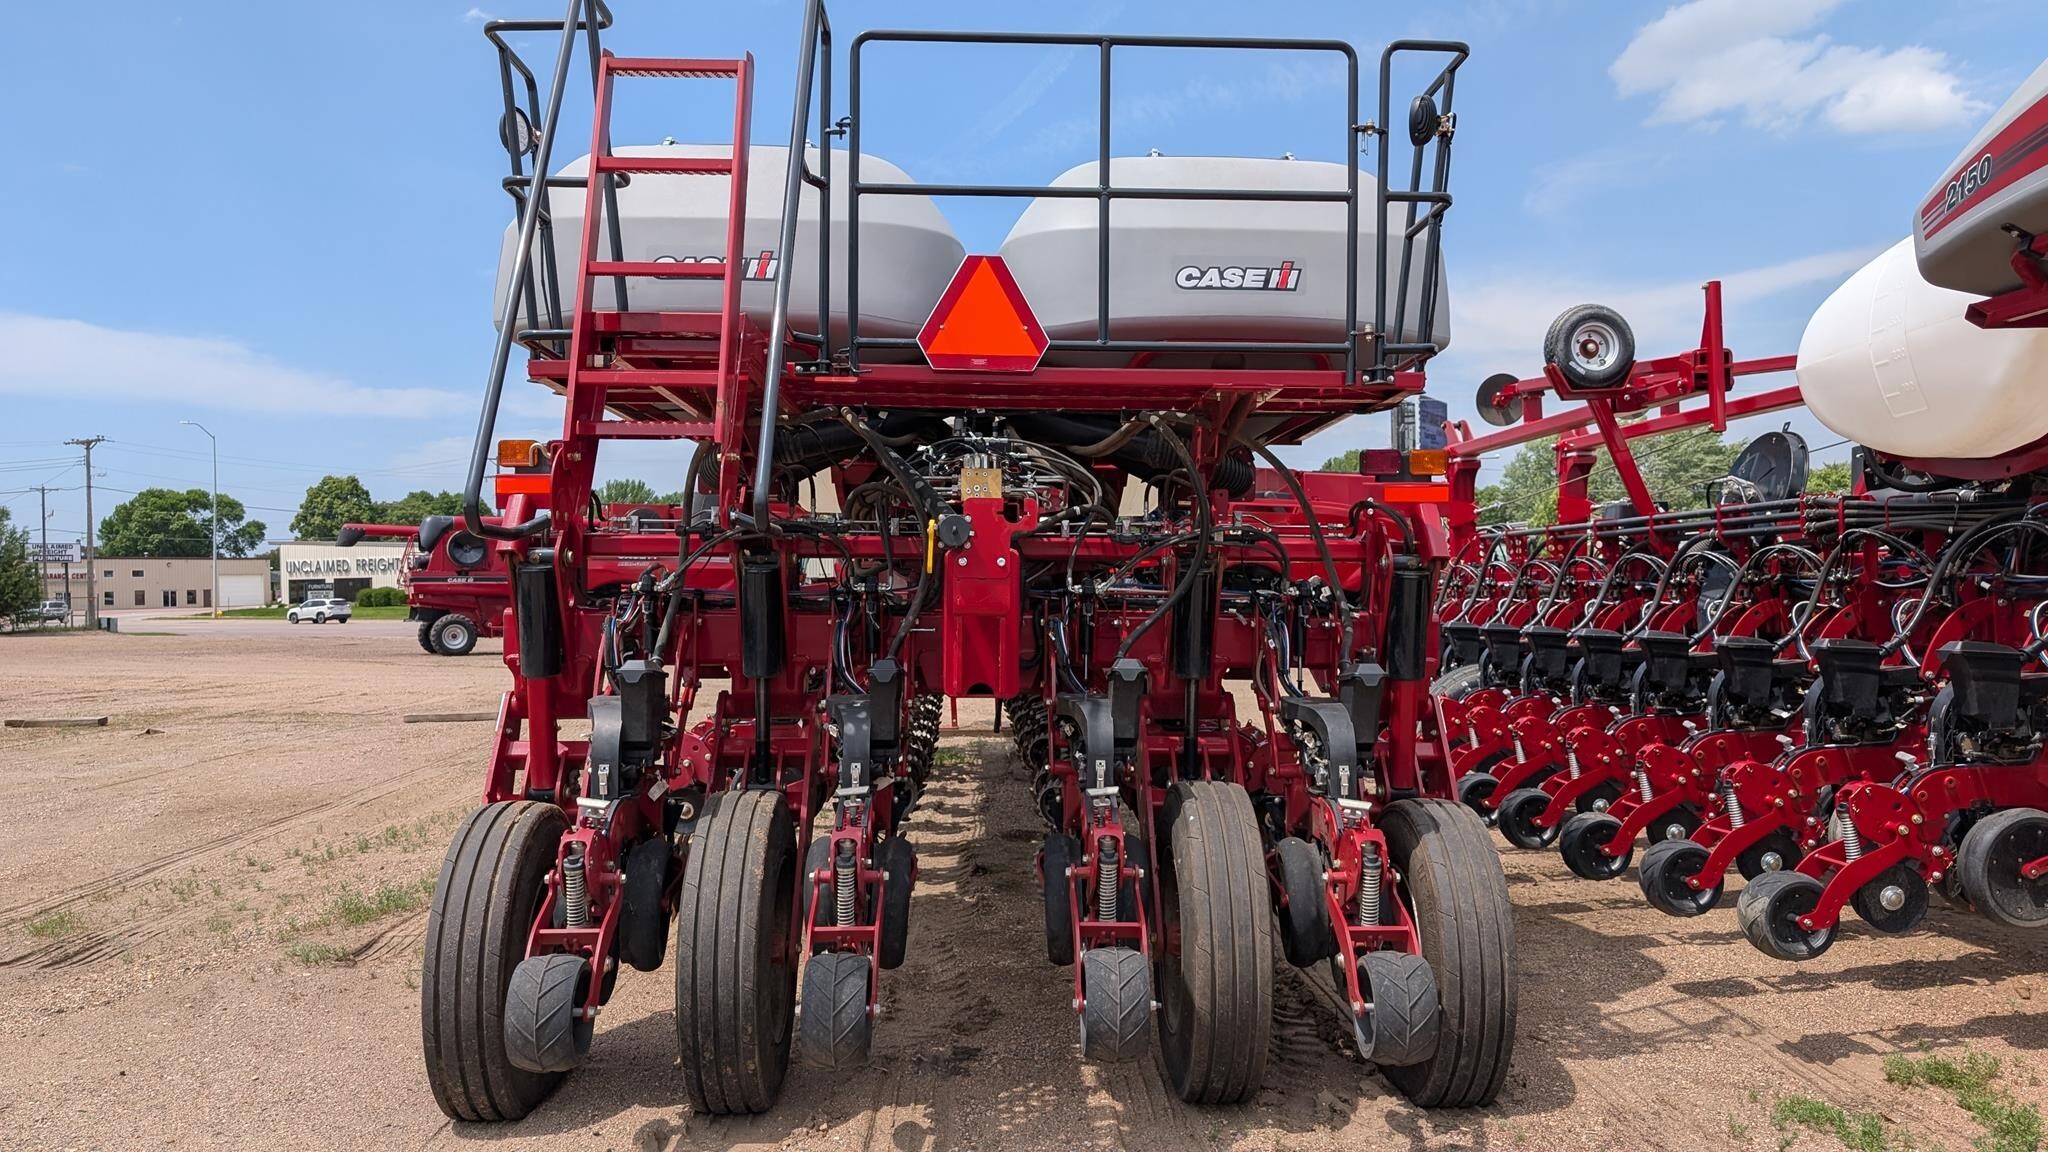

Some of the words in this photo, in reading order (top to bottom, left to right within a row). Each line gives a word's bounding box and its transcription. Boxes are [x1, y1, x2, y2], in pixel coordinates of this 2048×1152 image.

[1944, 153, 1992, 213] 2150
[1175, 266, 1268, 290] CASE
[286, 560, 350, 574] UNCLAIMED
[356, 557, 400, 572] FREIGHT
